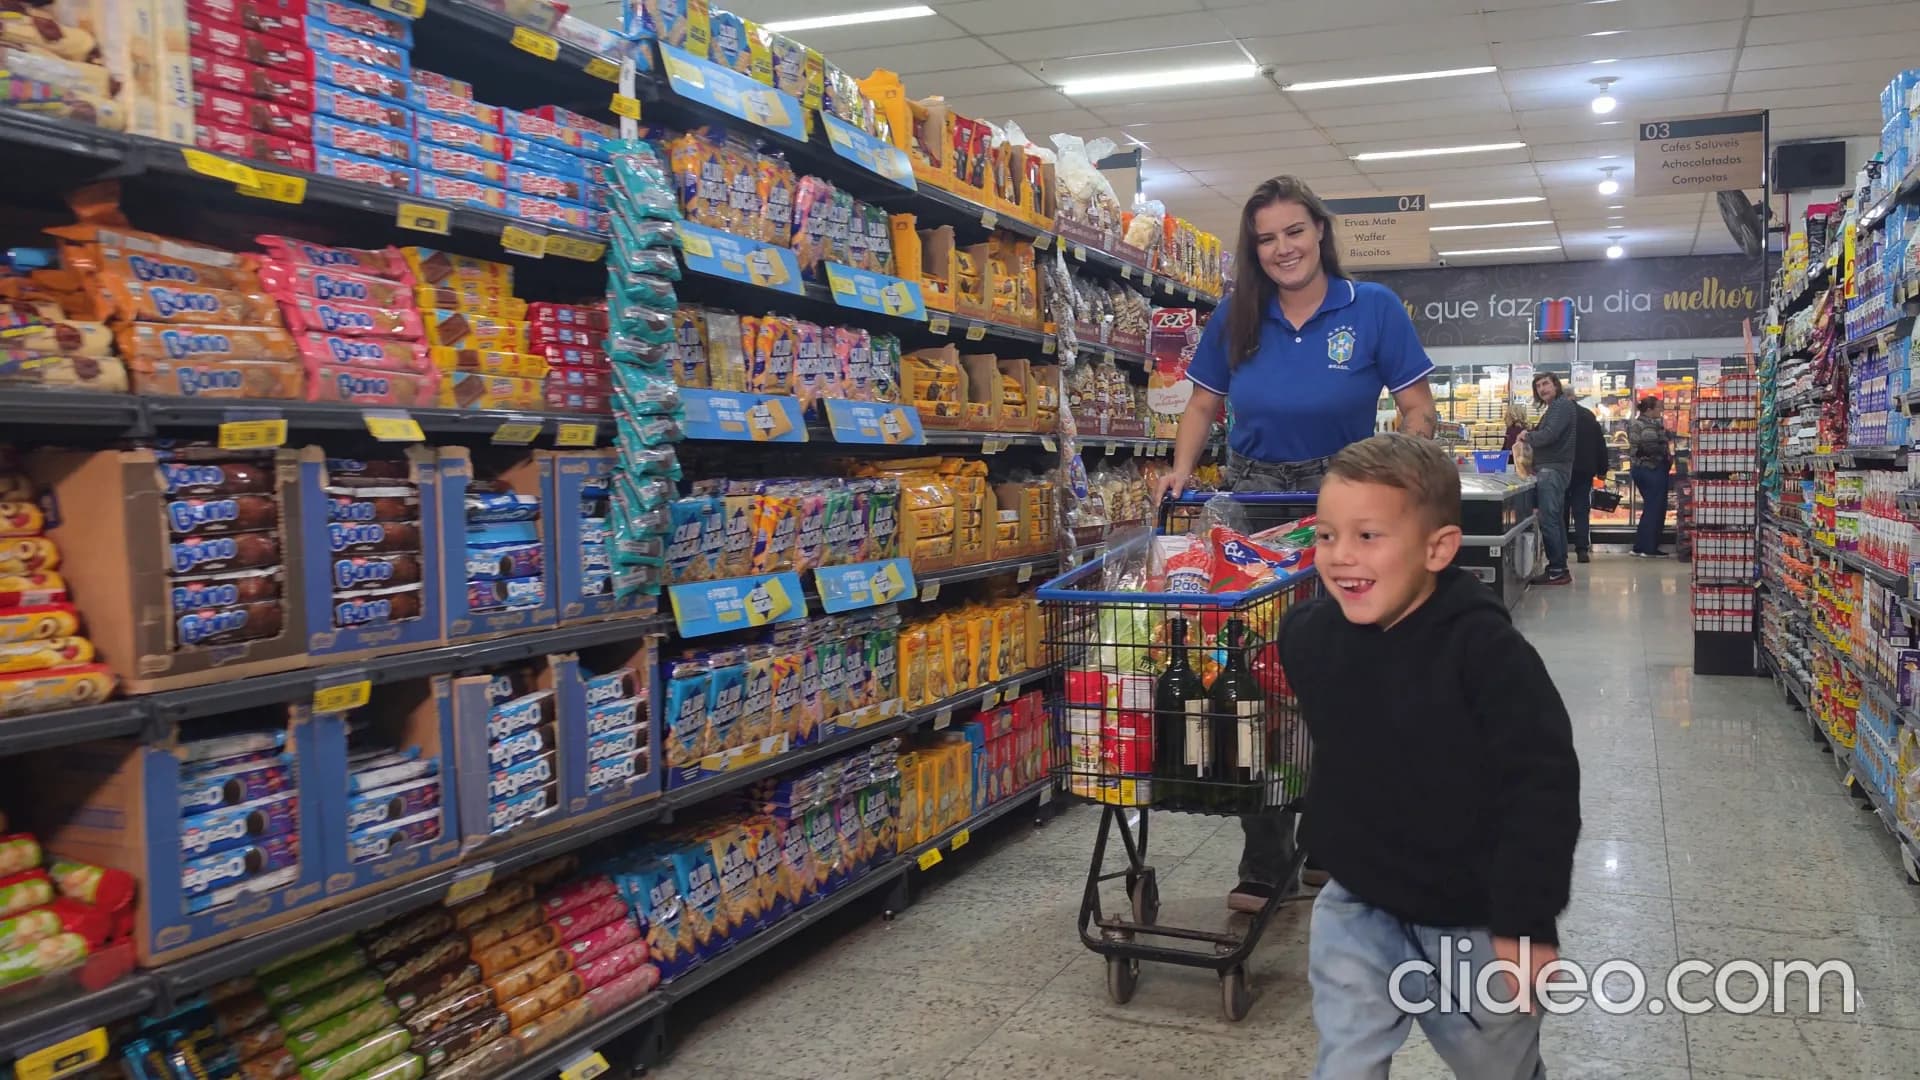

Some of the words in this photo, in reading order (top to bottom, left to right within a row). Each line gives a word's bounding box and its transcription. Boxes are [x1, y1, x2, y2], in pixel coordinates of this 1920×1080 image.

[1645, 123, 1670, 139] 03
[1662, 155, 1742, 169] Achocolatados
[1672, 174, 1728, 186] Compotas
[1398, 196, 1421, 211] 04
[1344, 218, 1369, 227] Ervas
[1372, 217, 1397, 226] Mate
[1350, 248, 1391, 257] Biscoitos
[315, 275, 367, 299] Bono
[1425, 299, 1479, 324] que
[1489, 294, 1533, 318] faz
[1603, 289, 1651, 313] dia
[1663, 277, 1760, 311] melhor
[319, 306, 373, 331] Bono
[329, 338, 383, 362] Bono
[337, 374, 389, 397] Bono
[169, 500, 239, 533] Bono
[328, 522, 384, 551] Bono
[170, 538, 238, 573] Bono
[335, 560, 393, 588] Bono
[1172, 578, 1199, 591] Pão
[177, 610, 248, 645] Bono
